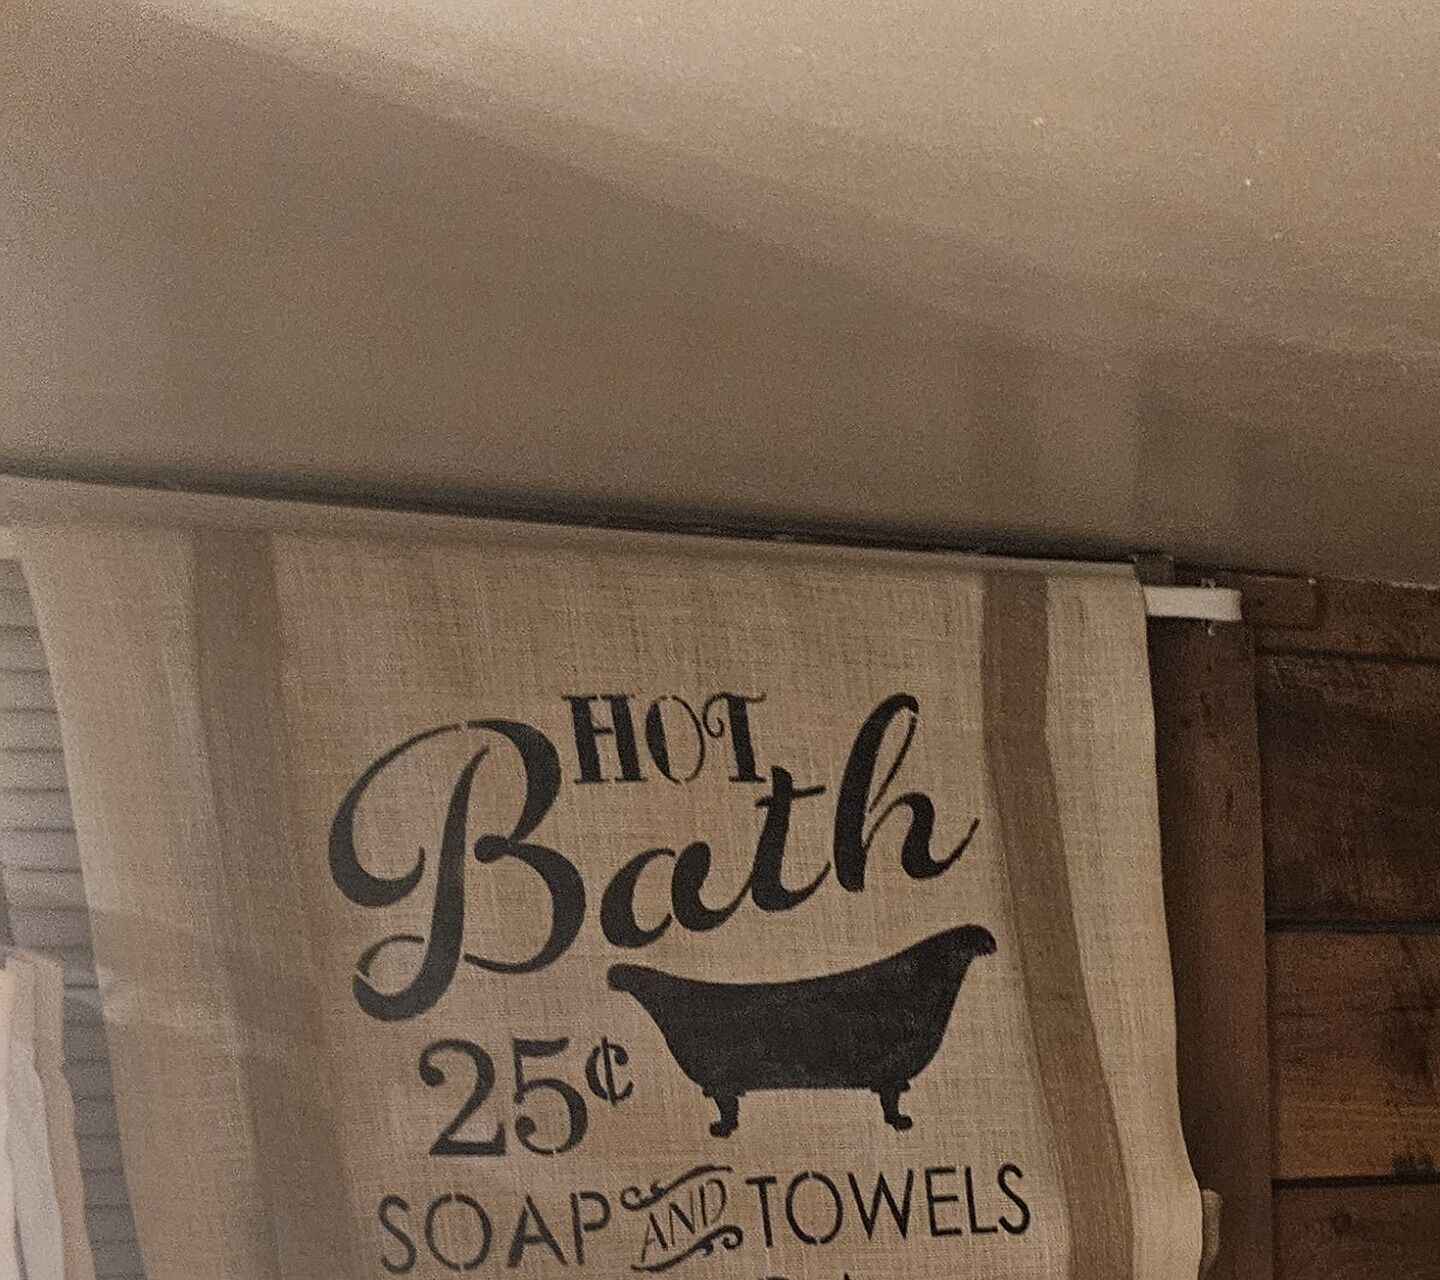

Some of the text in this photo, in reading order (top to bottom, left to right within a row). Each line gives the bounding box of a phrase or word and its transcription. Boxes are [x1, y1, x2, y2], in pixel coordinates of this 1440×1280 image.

[562, 692, 768, 786] HOT
[328, 693, 981, 1022] Bath
[418, 1036, 634, 1157] 25¢
[378, 1163, 1031, 1275] SOAP AND TOWELS
